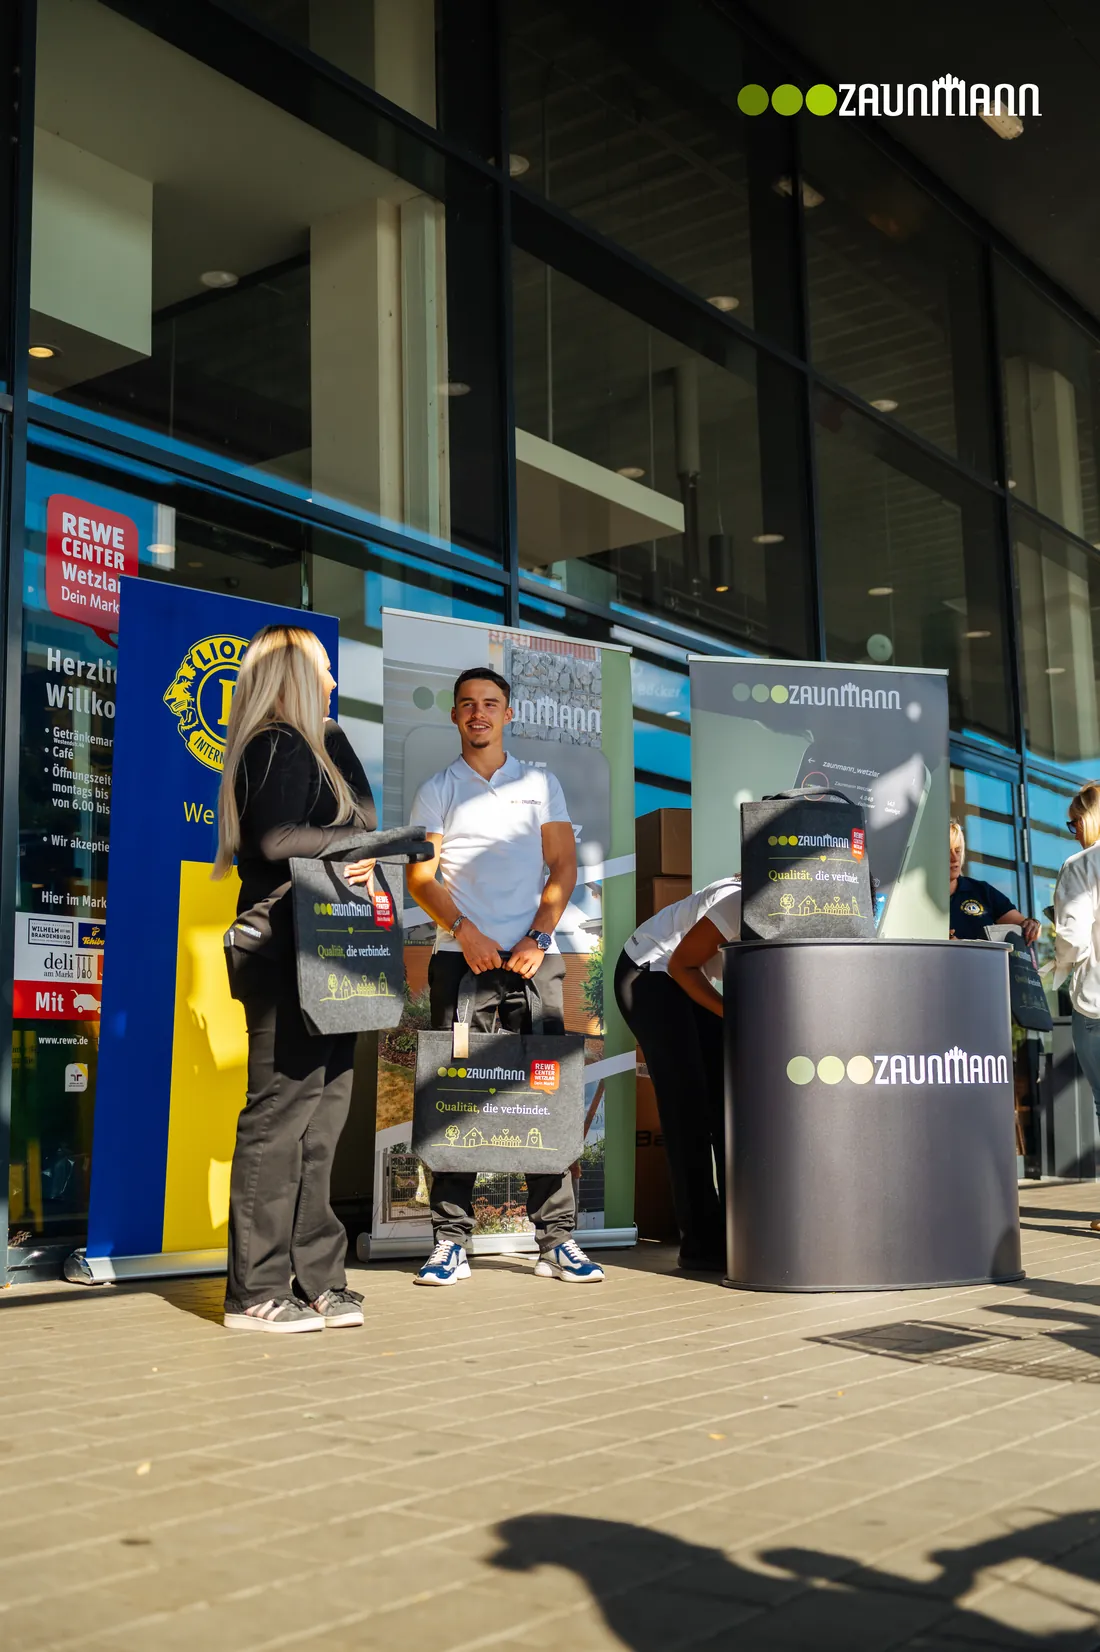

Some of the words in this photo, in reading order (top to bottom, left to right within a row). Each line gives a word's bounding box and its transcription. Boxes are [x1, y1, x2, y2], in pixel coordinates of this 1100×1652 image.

[62, 511, 125, 550] REWE
[61, 537, 125, 571] CENTER
[61, 585, 87, 606] Dein
[789, 682, 902, 710] ZAUNMANN
[52, 746, 74, 760] Café
[52, 763, 112, 786] Öffnungszeit
[52, 783, 93, 799] montags
[95, 787, 109, 800] bis
[52, 798, 69, 809] von
[72, 799, 94, 812] 6.00
[96, 803, 110, 815] bis
[183, 801, 214, 825] We
[51, 834, 67, 848] Wir
[798, 834, 849, 849] ZAUNMANN
[768, 869, 813, 882] Qualität,
[815, 871, 830, 881] die
[41, 890, 63, 905] Hier
[66, 893, 79, 906] im
[331, 901, 372, 917] ZAUNMANN
[31, 925, 59, 933] WILHELM
[31, 932, 71, 940] BRANDENBURG
[317, 945, 346, 959] Qualität,
[346, 945, 358, 957] die
[358, 945, 391, 957] verbindet.
[43, 952, 74, 971] deli
[55, 970, 74, 979] Markt
[35, 992, 64, 1013] Mit
[38, 1036, 88, 1046] www.rewe.de
[874, 1045, 1009, 1085] ZAUNMANN
[466, 1066, 526, 1081] ZAUNMANN
[435, 1101, 480, 1114] Qualität,
[482, 1103, 499, 1113] die
[500, 1104, 551, 1116] verbindet.
